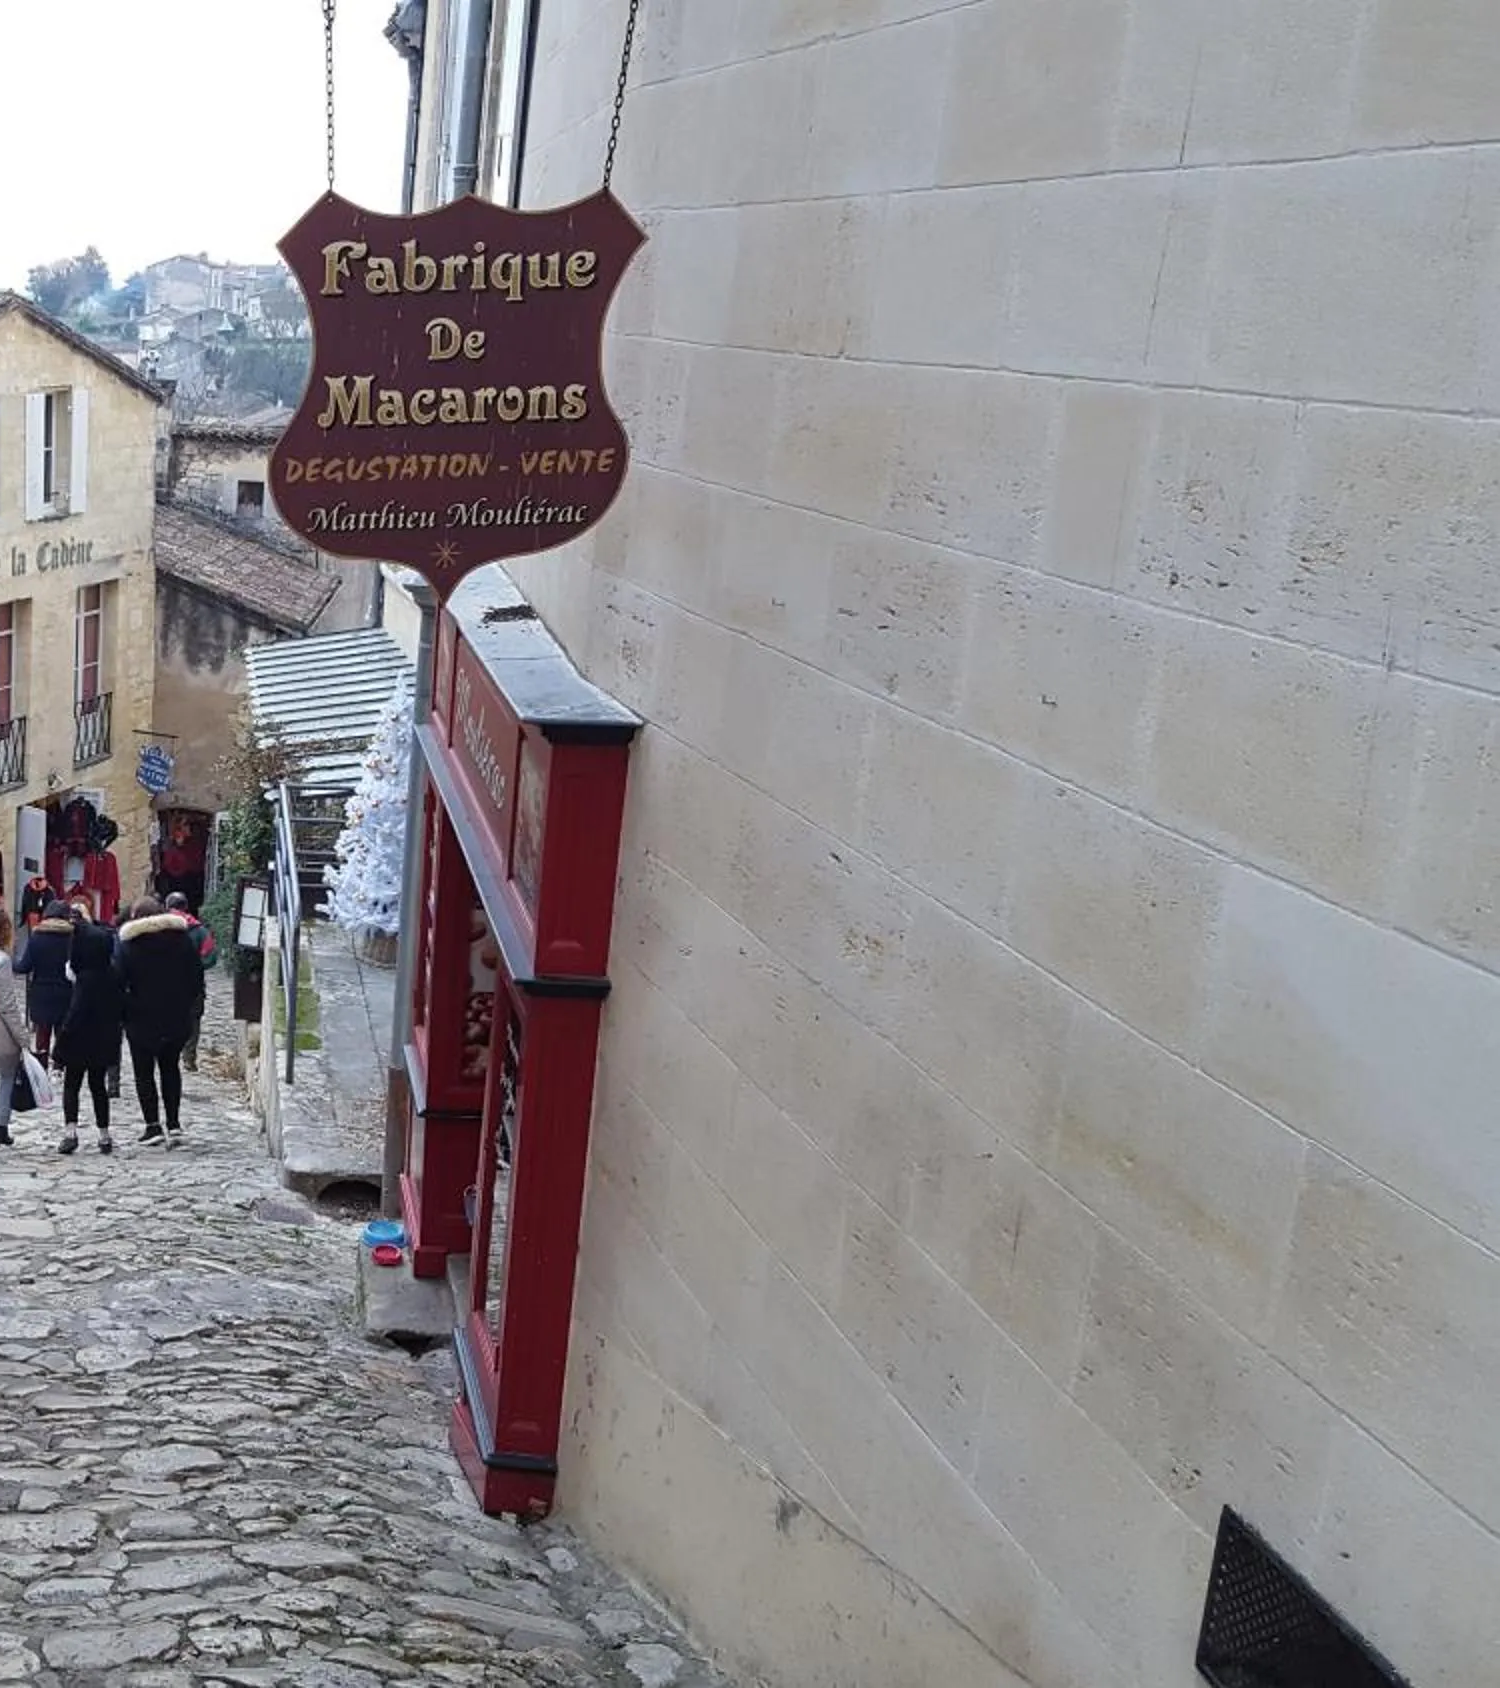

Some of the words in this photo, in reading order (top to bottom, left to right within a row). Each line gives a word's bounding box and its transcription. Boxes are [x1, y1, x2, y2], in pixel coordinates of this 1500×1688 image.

[320, 240, 596, 302] Fabrique
[425, 318, 486, 360] De
[317, 376, 587, 428] Macarons
[285, 453, 488, 483] DEGUSTATION
[520, 448, 615, 475] VENTE
[306, 501, 436, 533] Matthieu
[445, 496, 588, 528] Mouliérac
[11, 547, 26, 577] la
